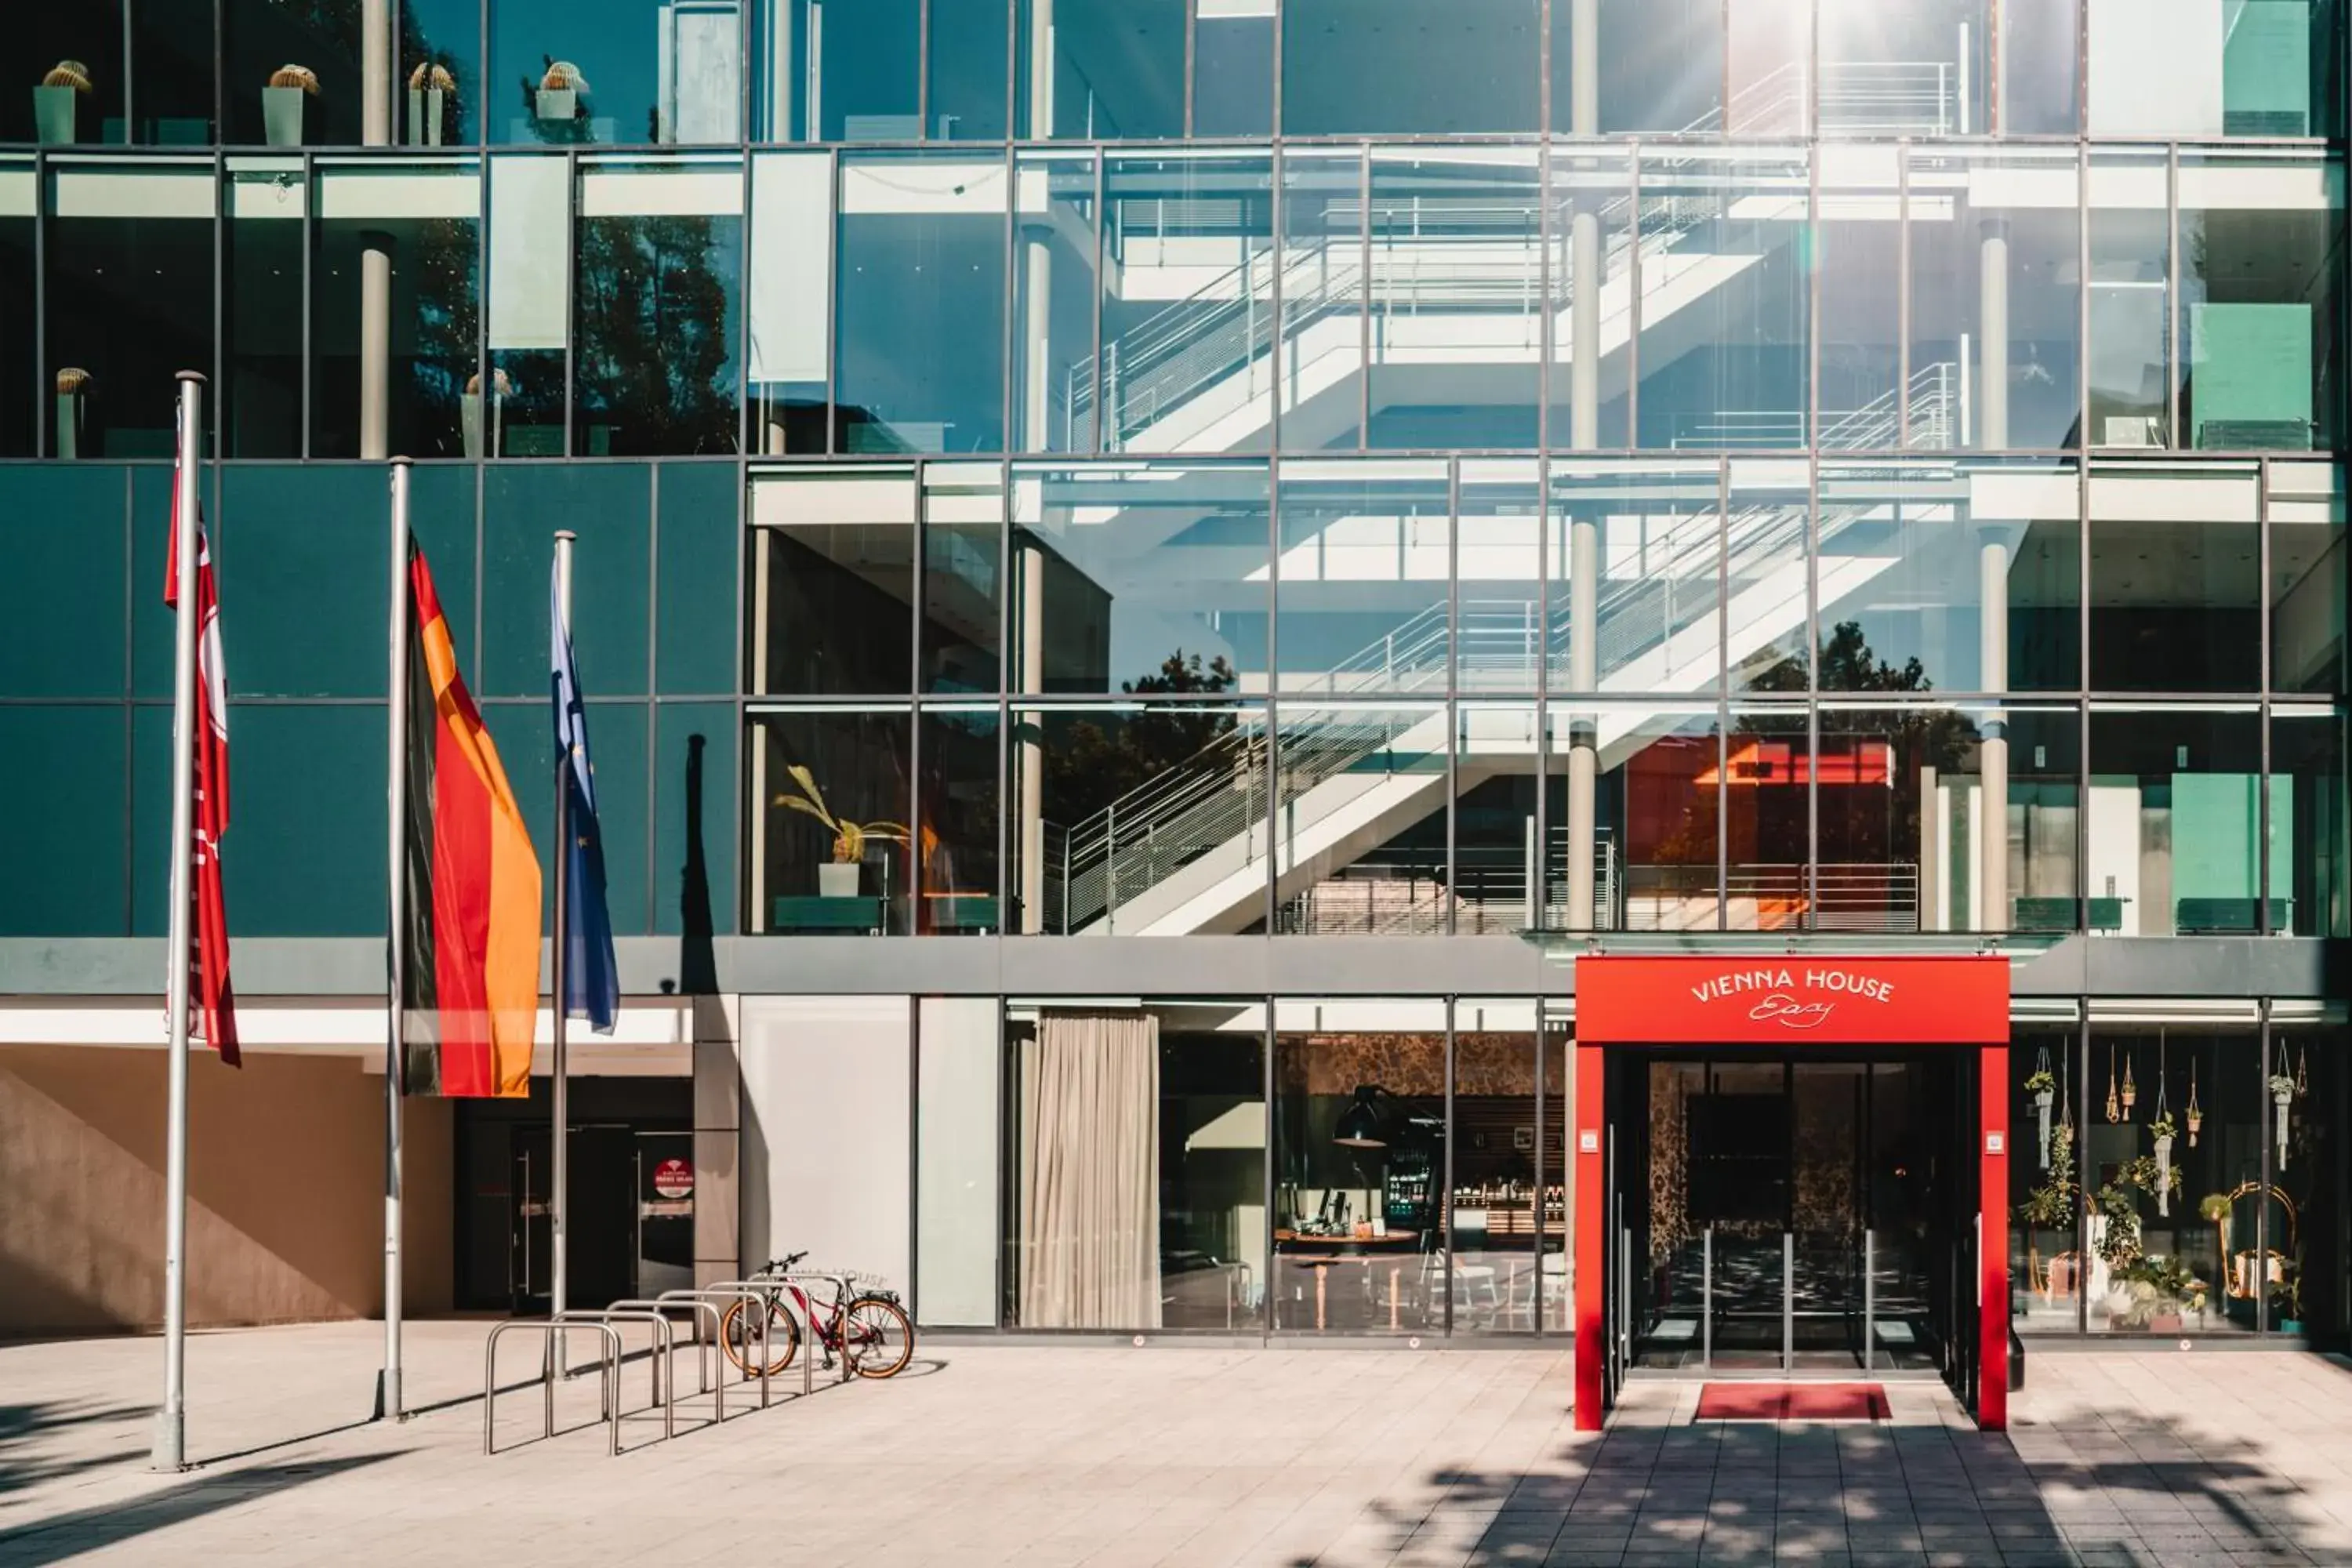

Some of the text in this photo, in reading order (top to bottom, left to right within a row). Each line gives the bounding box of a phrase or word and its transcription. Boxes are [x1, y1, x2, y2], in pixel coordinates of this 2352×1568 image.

[1690, 968, 1895, 1003] VIENNA HOUSE
[1748, 993, 1835, 1028] Easy
